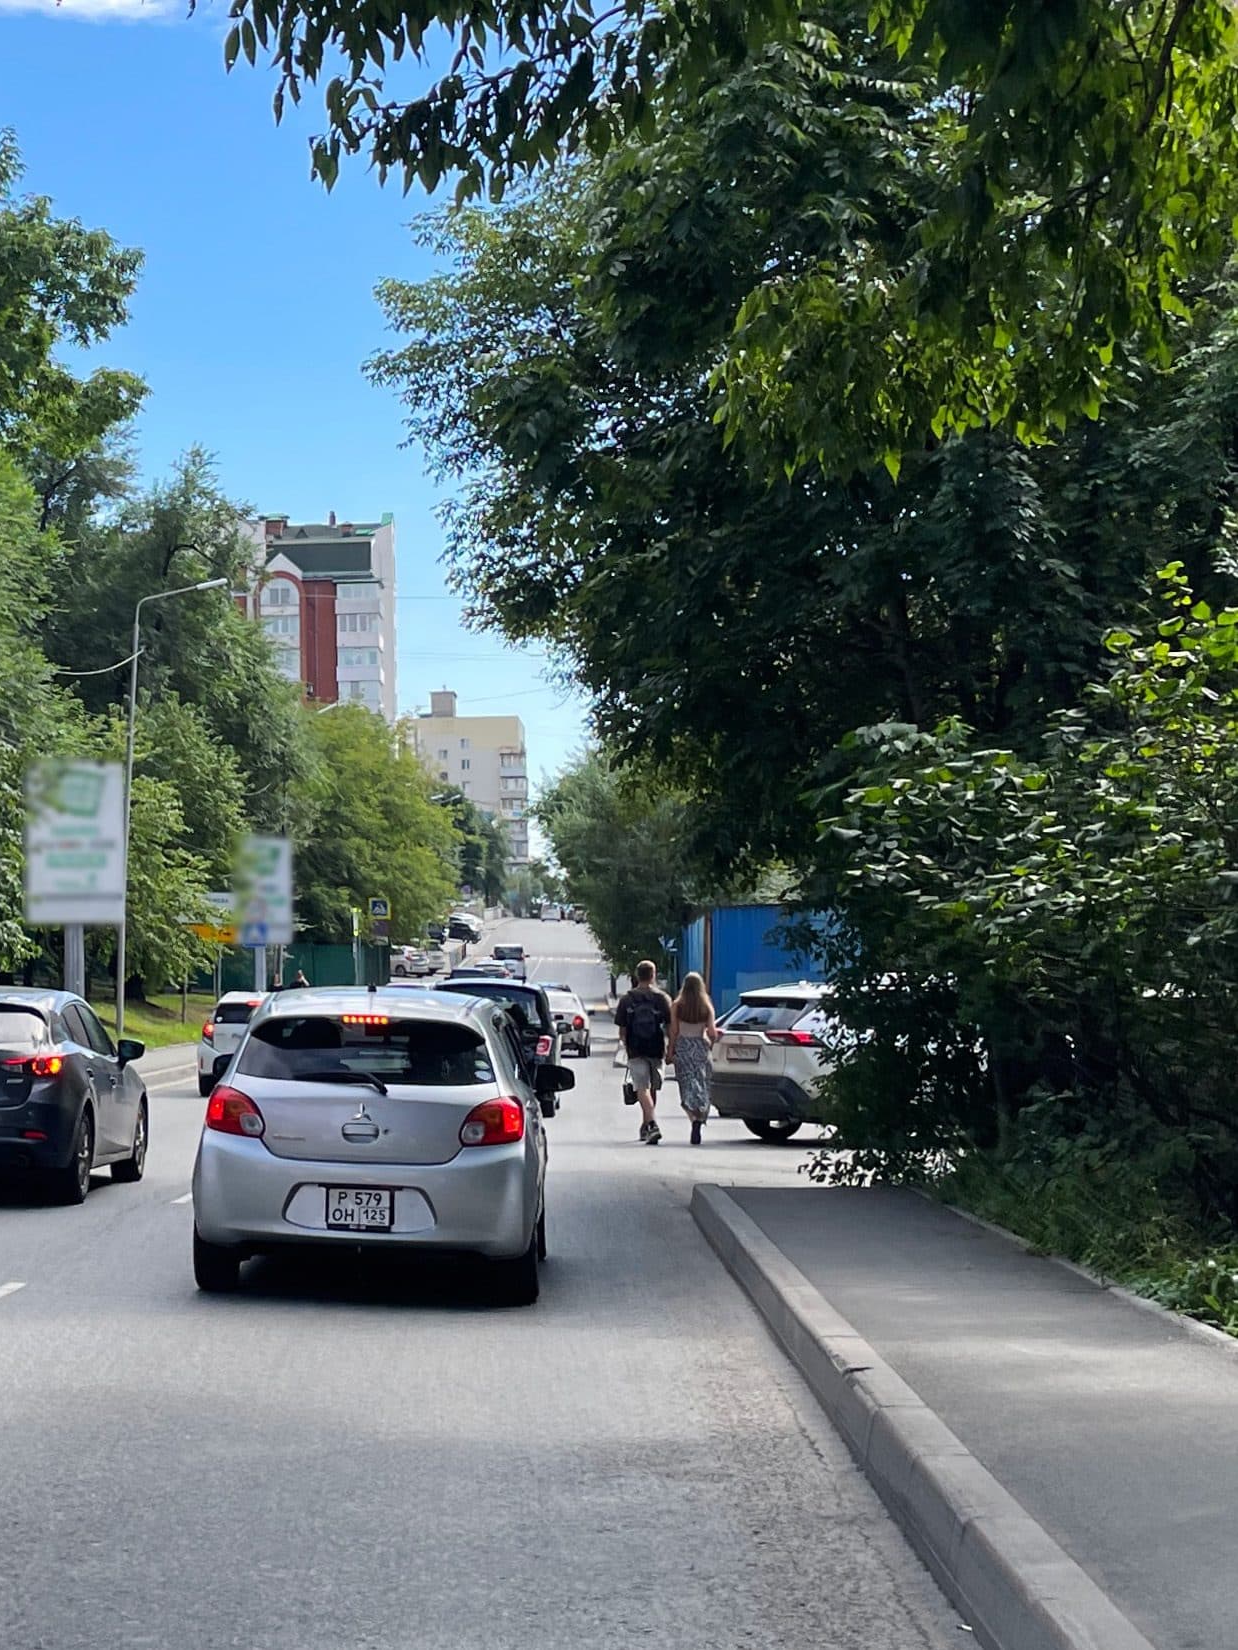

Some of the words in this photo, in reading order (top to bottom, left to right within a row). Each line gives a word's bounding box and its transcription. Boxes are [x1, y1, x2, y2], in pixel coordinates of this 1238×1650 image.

[338, 1191, 348, 1205] Р
[355, 1191, 382, 1206] 579
[332, 1208, 354, 1222] ОН
[363, 1209, 386, 1220] 125
